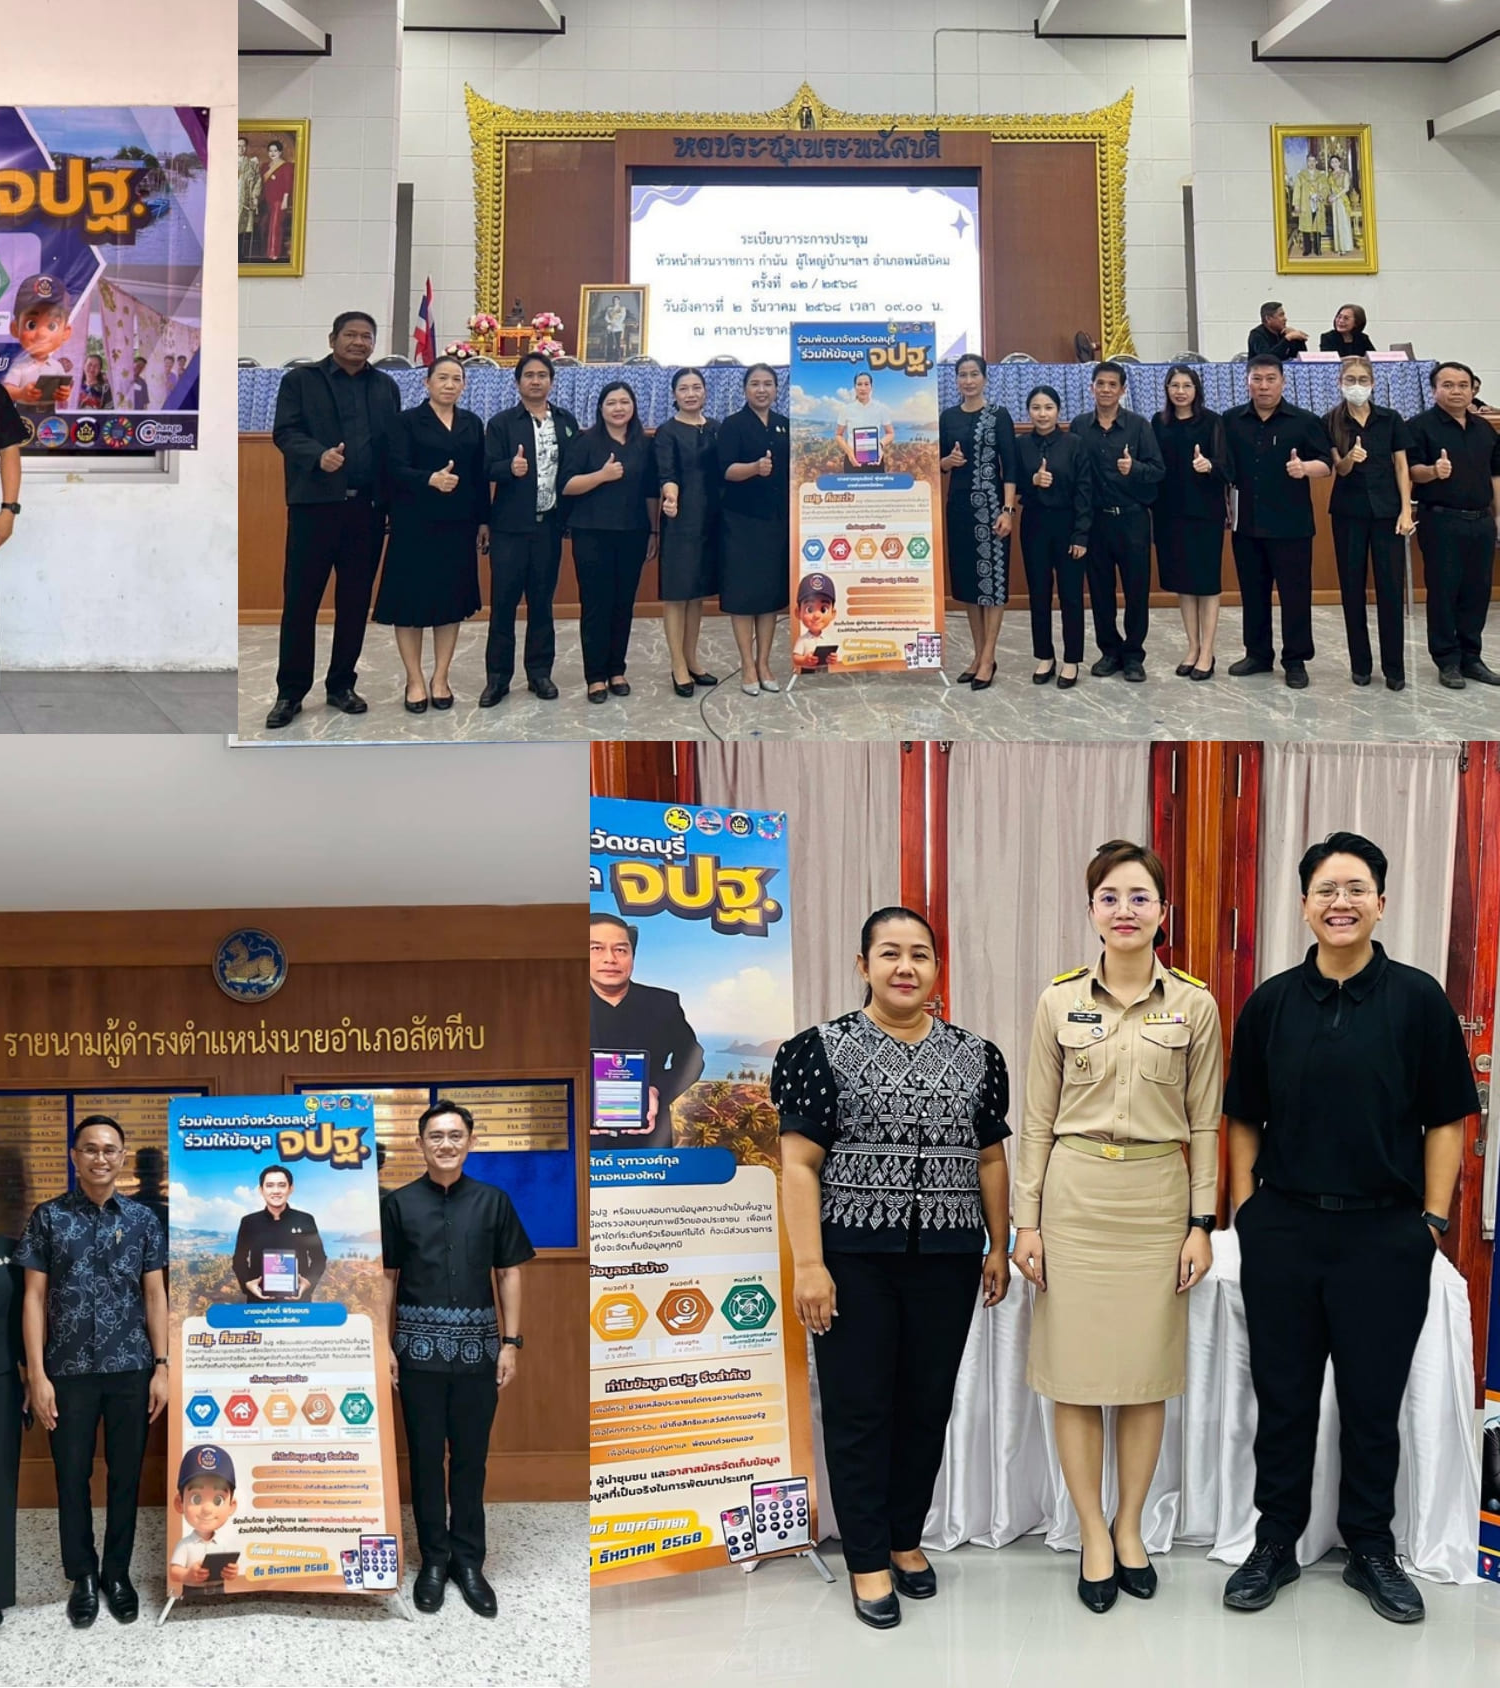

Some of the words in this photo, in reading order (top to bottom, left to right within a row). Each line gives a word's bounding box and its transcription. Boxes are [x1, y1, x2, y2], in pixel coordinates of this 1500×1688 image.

[740, 232, 869, 248] ระเบียบวาระการประชุม
[750, 299, 798, 314] ธันวาคม
[713, 322, 791, 338] ศาลาประชาค
[869, 342, 932, 373] จปฐ.
[590, 828, 686, 861] วัดชลบุรี
[615, 855, 776, 925] จปฐ.
[3, 1013, 485, 1068] รายนามผู้ดำรงตำแหน่งนายอำเภอสัตหีบ
[178, 1112, 316, 1129] ร่วมพัฒนาจังหวัดชลบุรี
[183, 1130, 272, 1150] ร่วมให้ข้อมูล
[278, 1122, 369, 1164] จปฐ.
[662, 1531, 703, 1550] 2568
